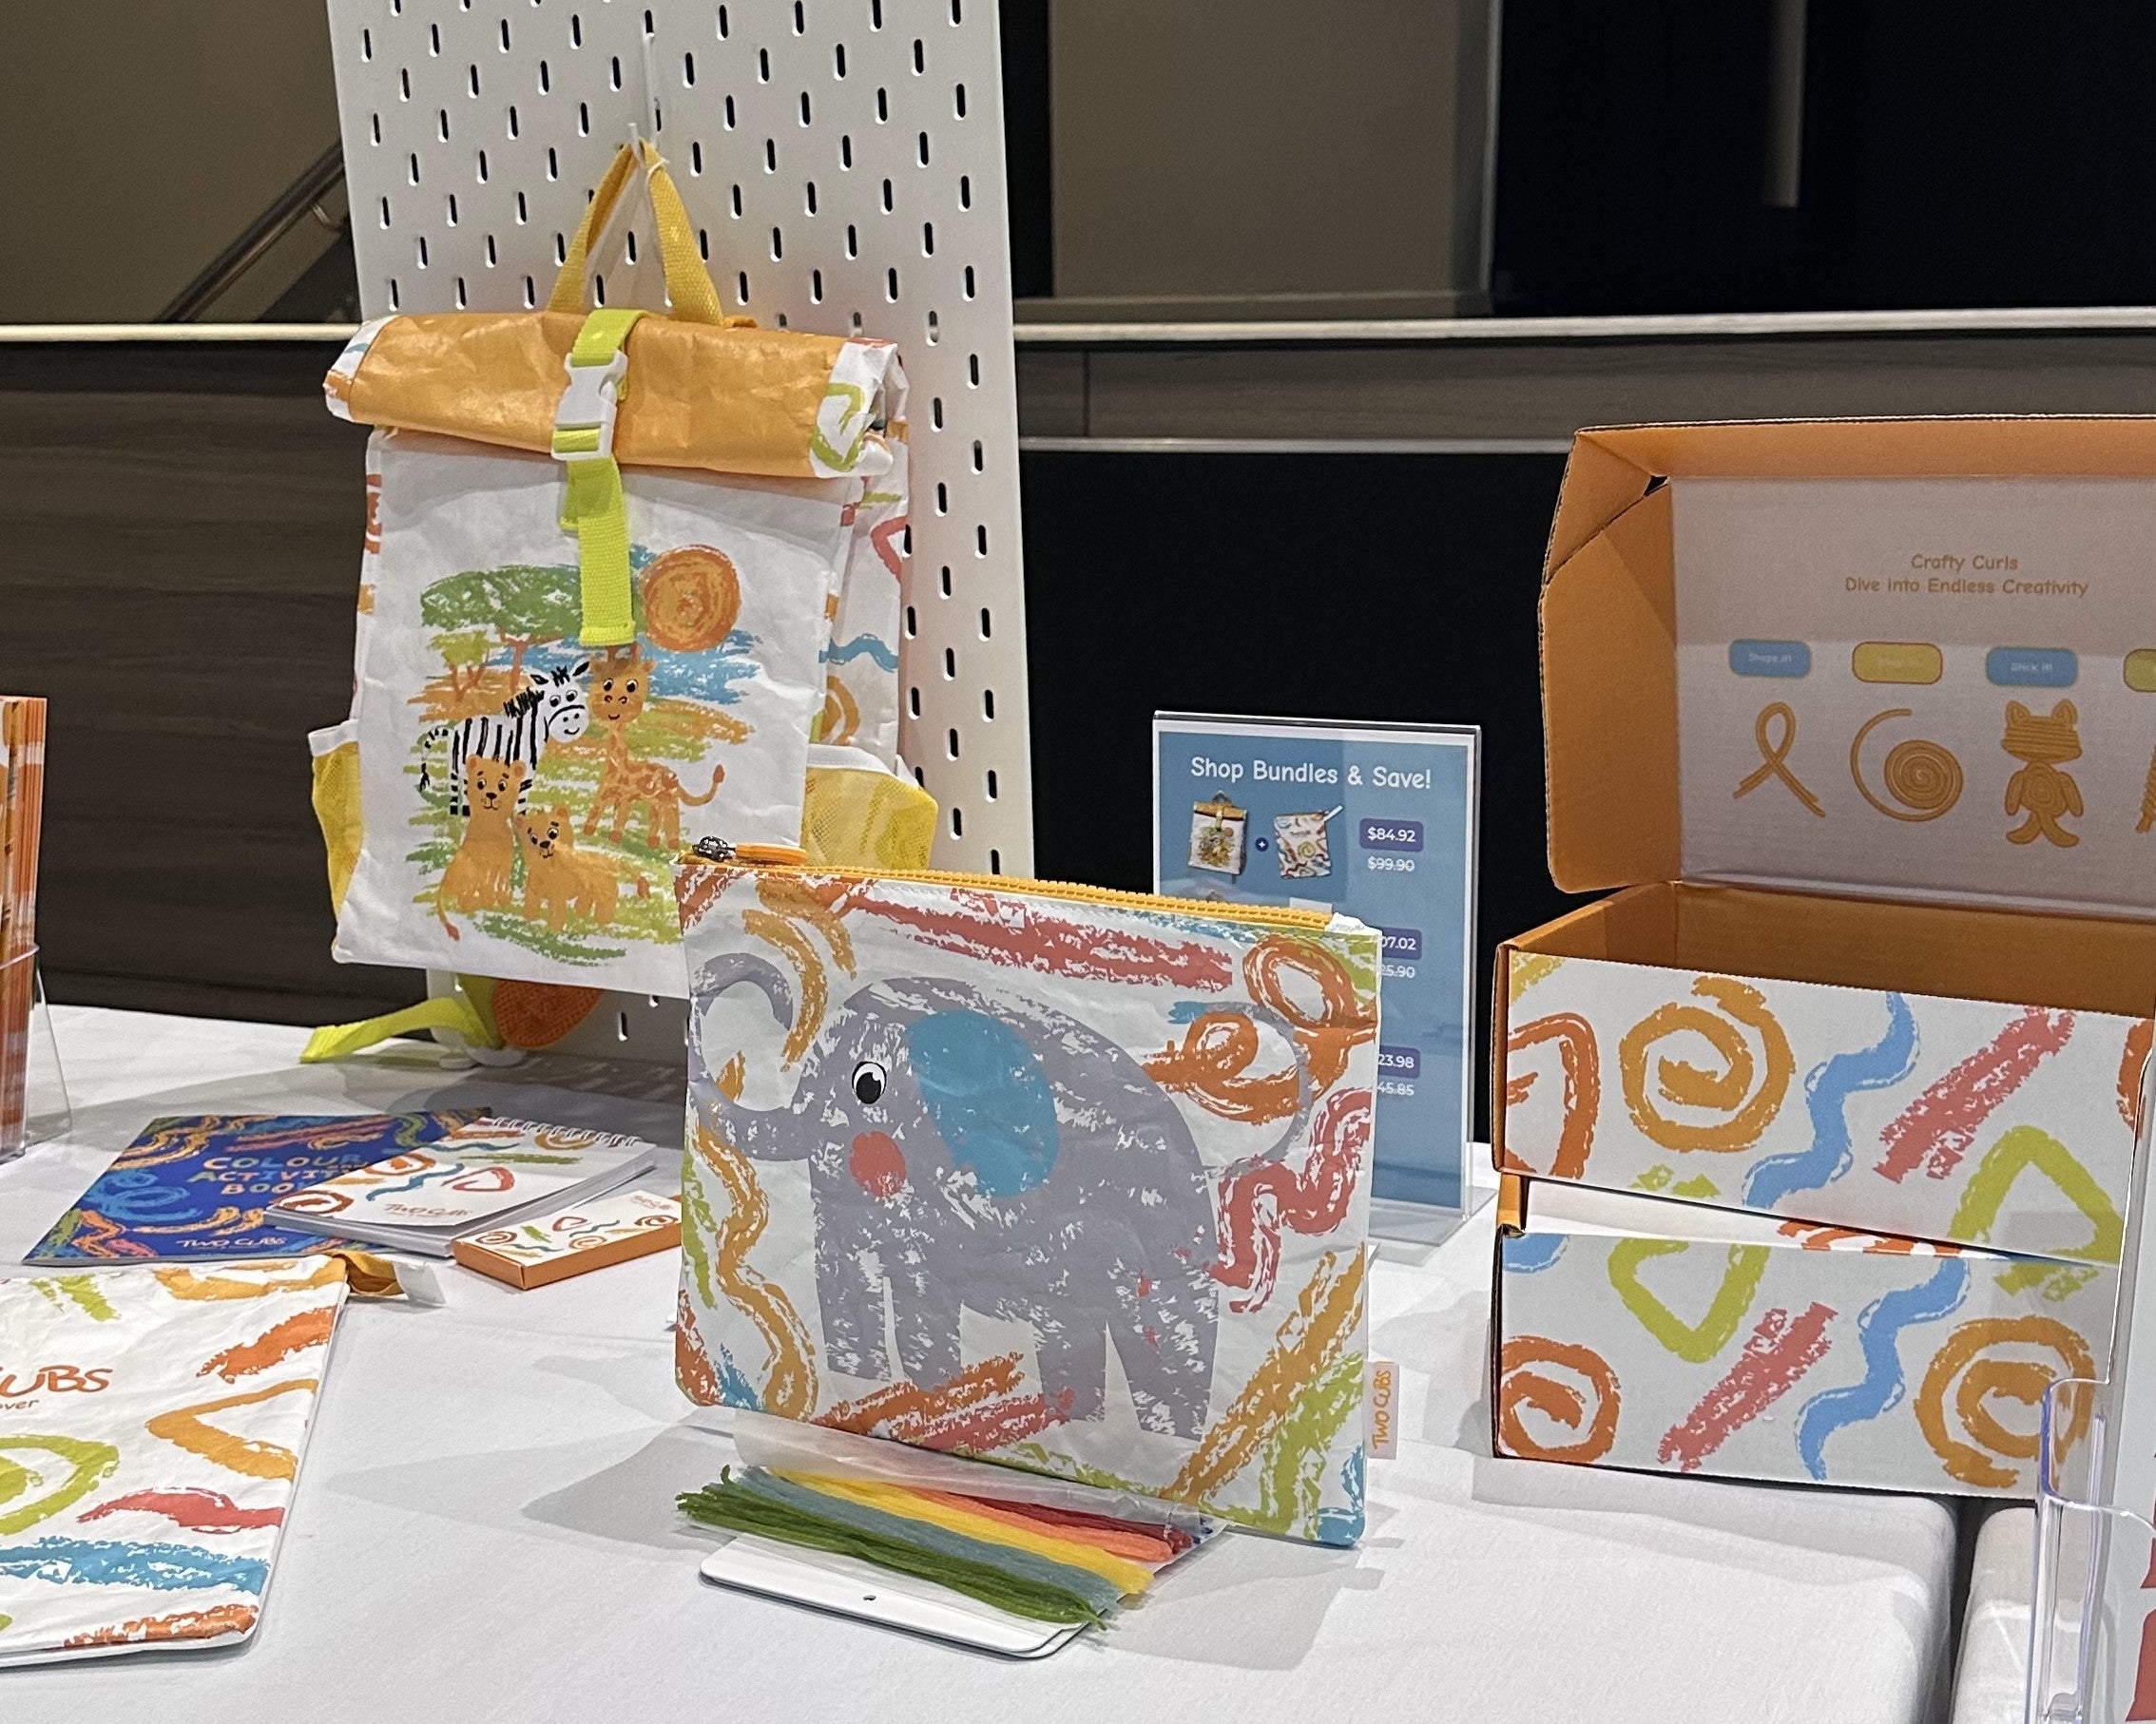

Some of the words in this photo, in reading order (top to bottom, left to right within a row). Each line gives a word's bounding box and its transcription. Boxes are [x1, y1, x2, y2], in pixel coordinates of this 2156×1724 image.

[1911, 554, 1966, 573] Crafty
[1972, 554, 2019, 570] Curls
[1845, 577, 1880, 592] Dive
[1928, 578, 1995, 594] Endless
[2002, 579, 2089, 597] Creativity
[1190, 756, 1244, 784] Shop
[1252, 758, 1338, 785] Bundles
[1347, 764, 1363, 786] &
[1372, 765, 1432, 790] Save!
[1367, 826, 1416, 843] $84.92
[1367, 855, 1415, 872] $99.90
[203, 1153, 361, 1170] COLOUR
[186, 1169, 350, 1183] ACTIVIT
[0, 1364, 114, 1398] UBS
[1373, 1369, 1392, 1408] CUBS
[1372, 1410, 1391, 1450] TWO
